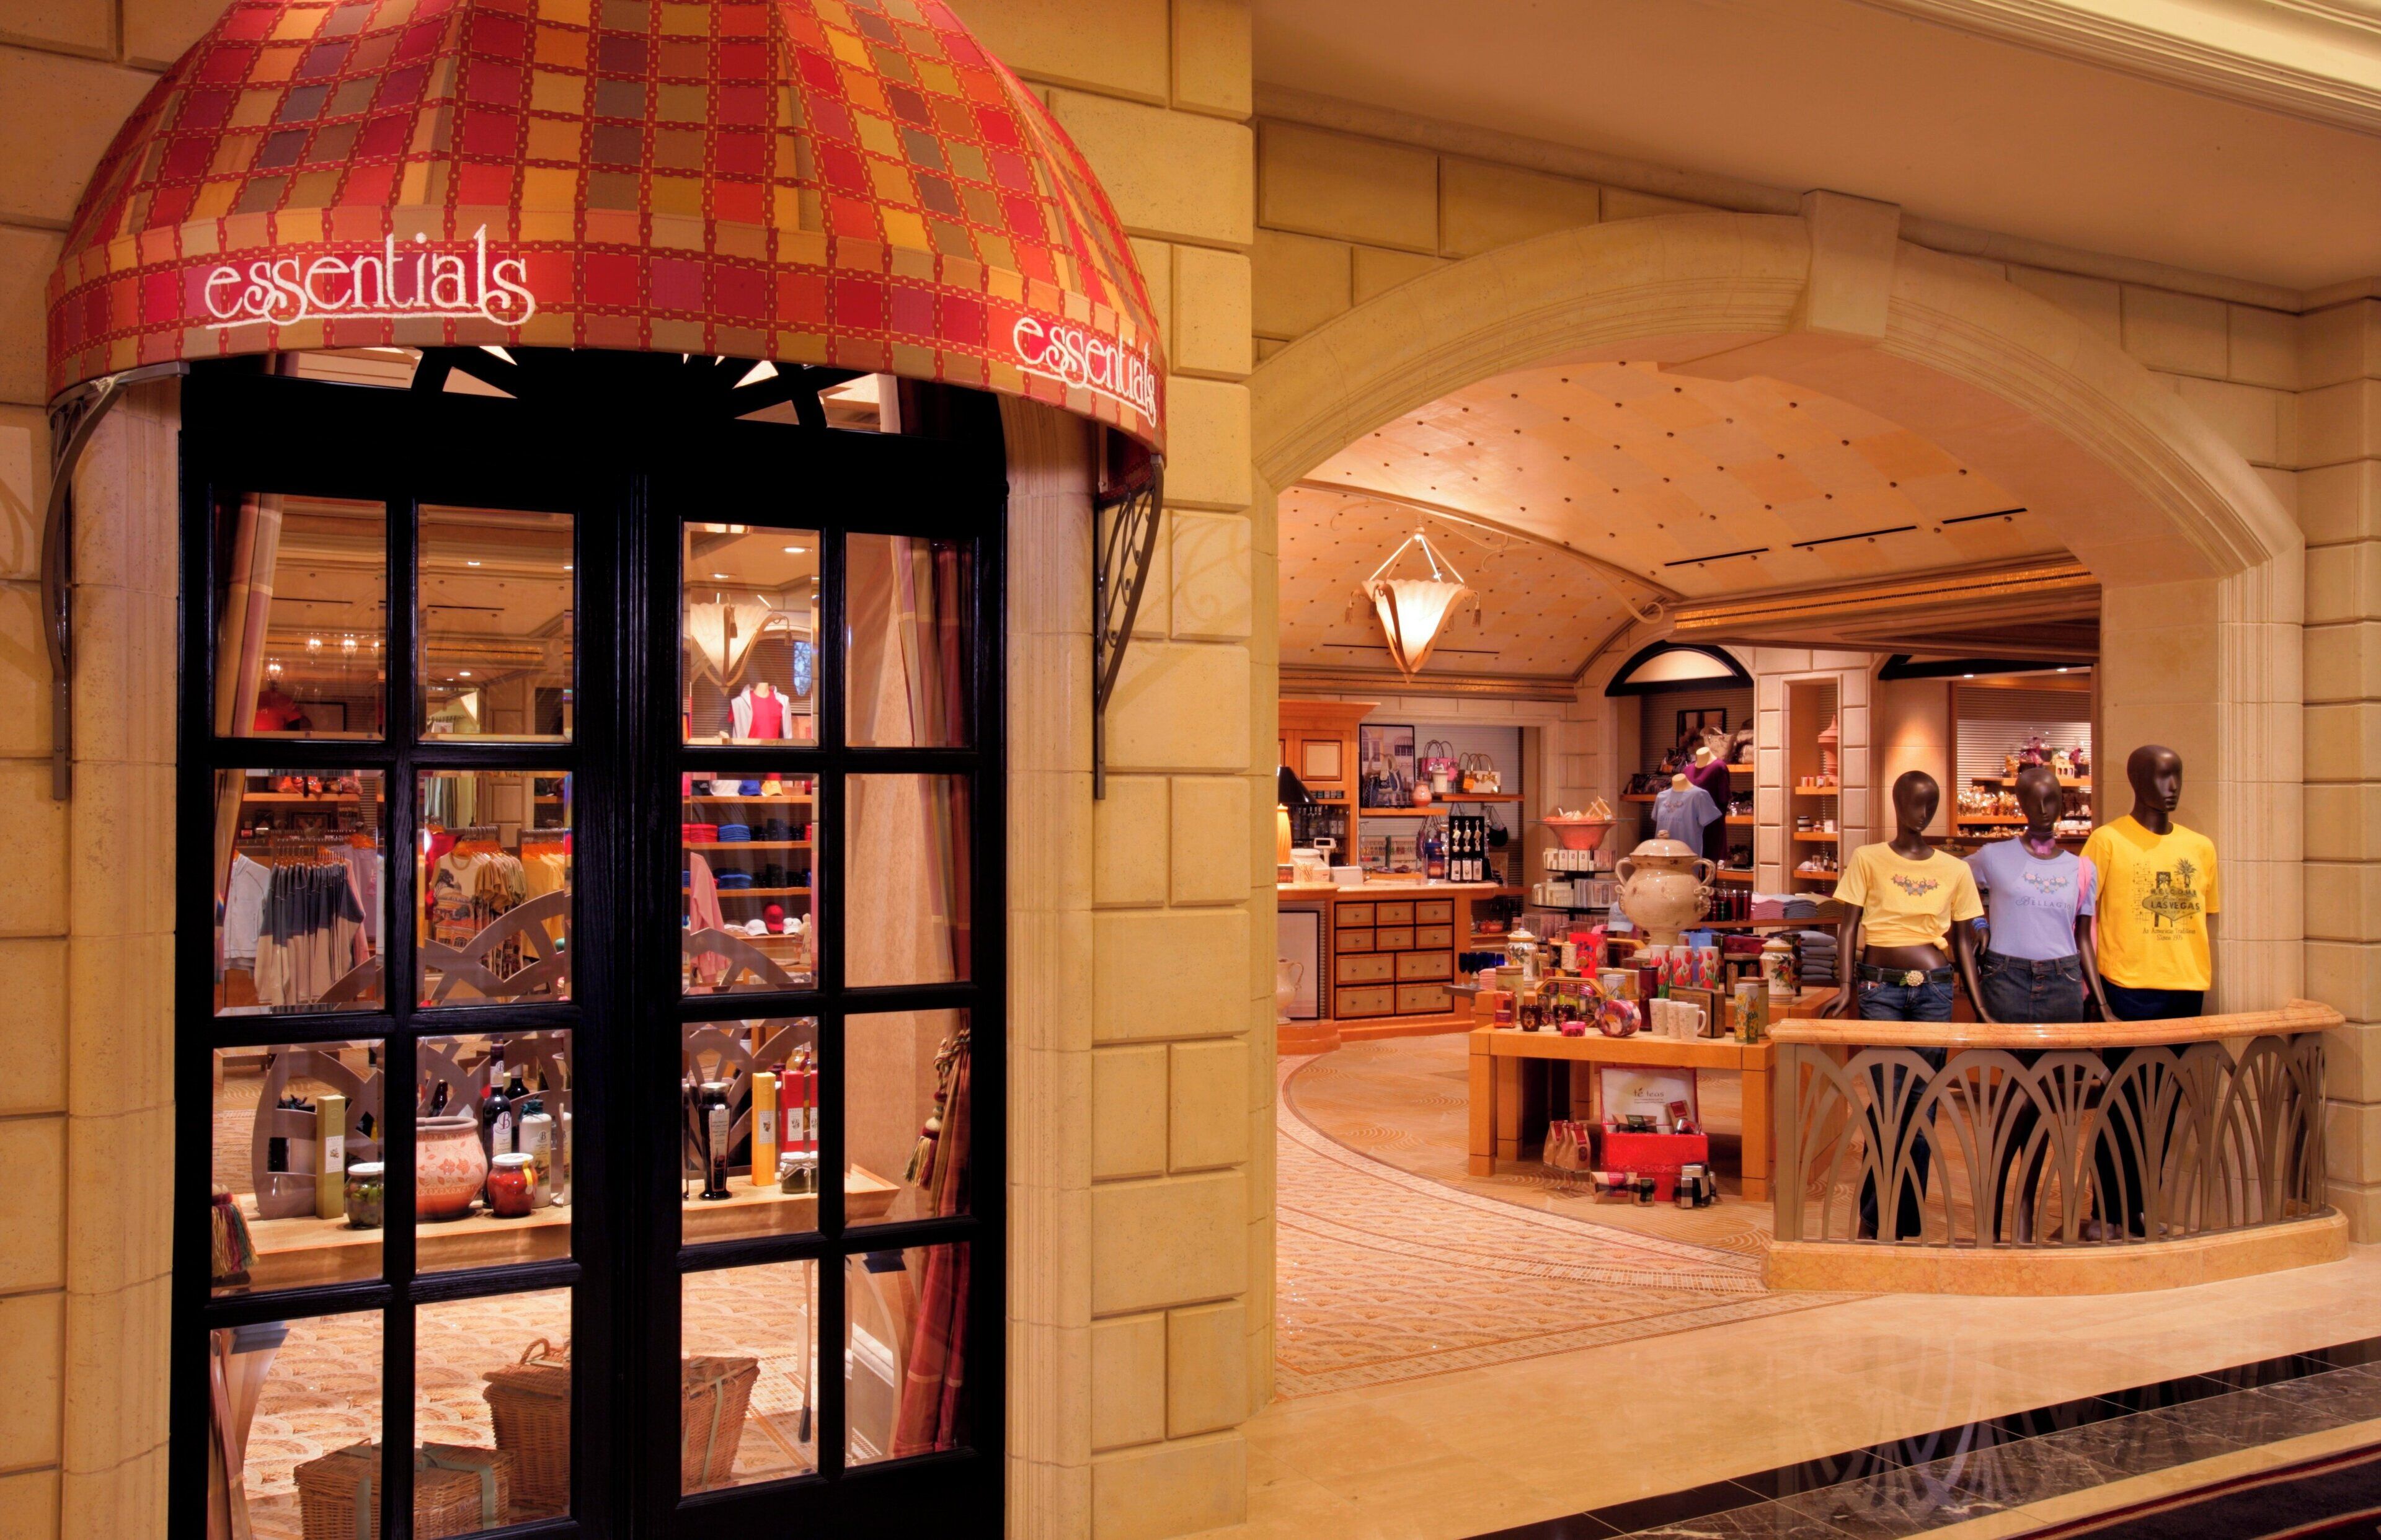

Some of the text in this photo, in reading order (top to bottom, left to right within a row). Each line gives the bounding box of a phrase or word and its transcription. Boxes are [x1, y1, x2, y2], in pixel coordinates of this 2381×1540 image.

[205, 223, 536, 327] essentials
[1013, 316, 1156, 428] essentials
[2015, 895, 2071, 909] BELLAGIO
[2169, 901, 2200, 910] VEGAS
[1634, 1087, 1643, 1097] té
[498, 1112, 510, 1130] B
